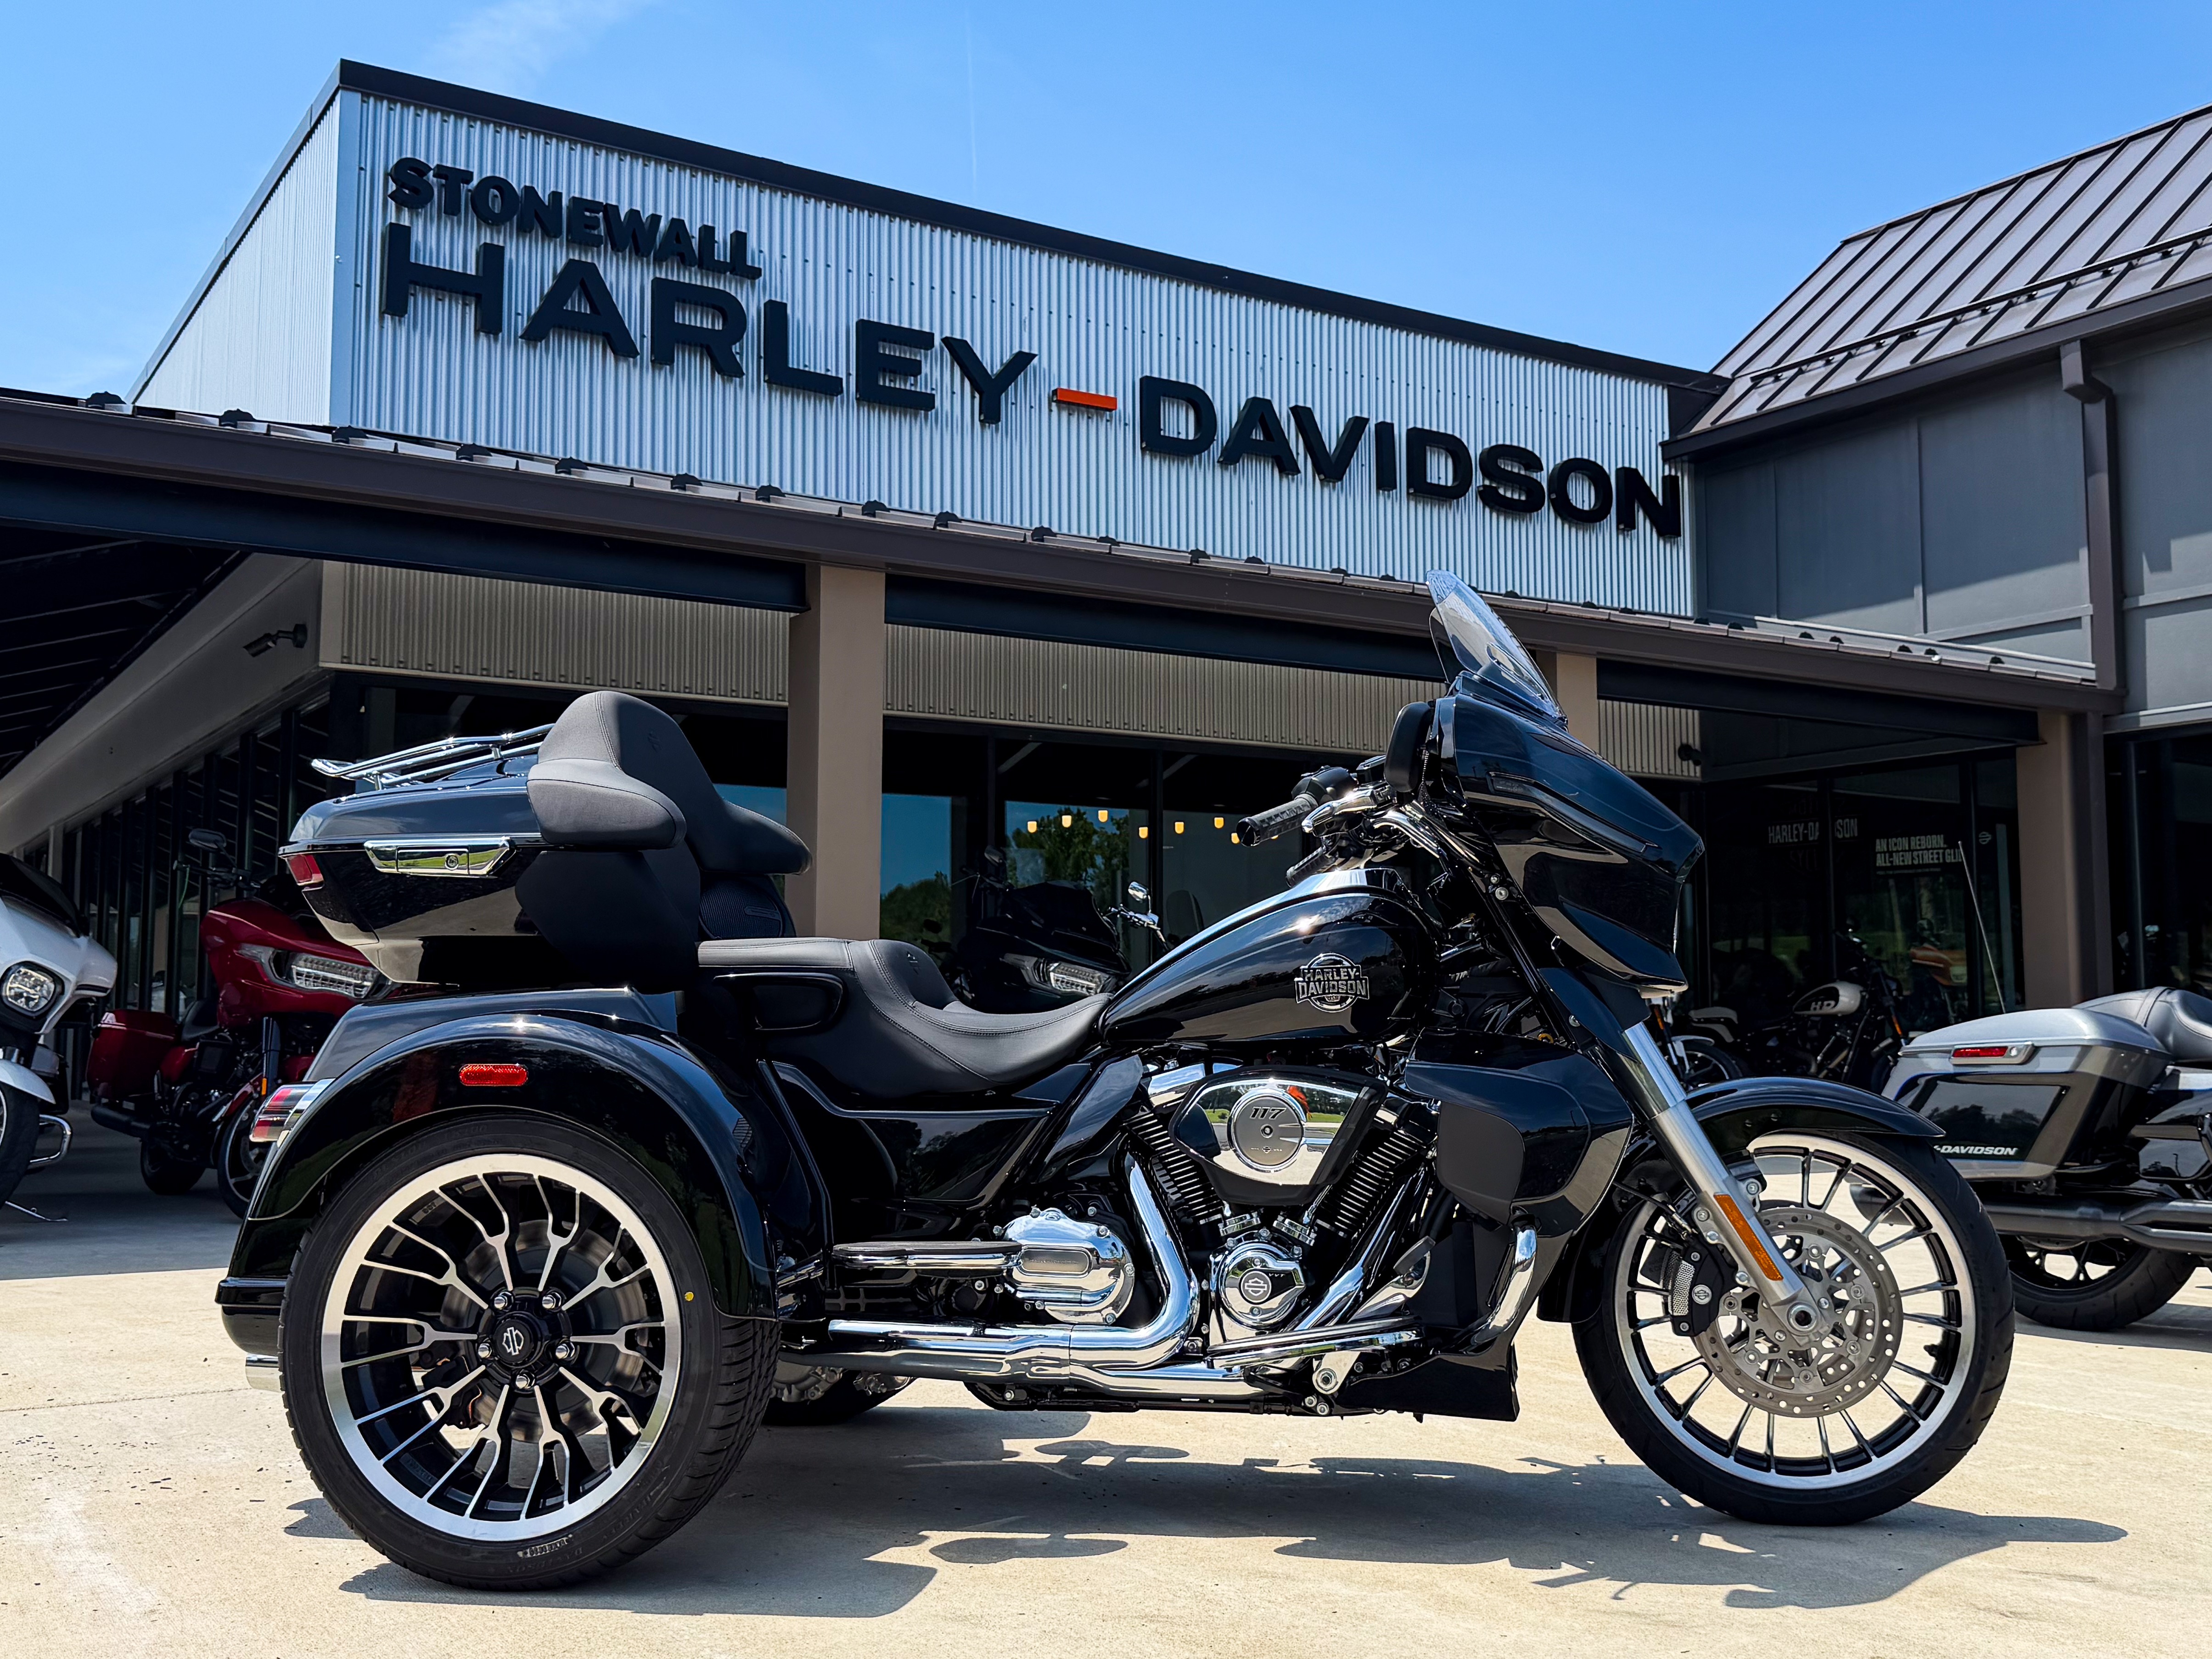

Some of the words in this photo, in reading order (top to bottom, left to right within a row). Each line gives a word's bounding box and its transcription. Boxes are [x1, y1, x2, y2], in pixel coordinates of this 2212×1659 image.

[388, 157, 762, 280] STONEWALL
[1768, 818, 1858, 844] HARLEY-DASON
[1875, 838, 1887, 852] AN
[1889, 837, 1909, 852] ICON
[1910, 834, 1949, 850] REBORN.
[1876, 851, 1912, 867] ALL-NEW
[1913, 849, 1944, 865] STREET
[1304, 968, 1359, 981] HARLEY-
[1298, 980, 1366, 999] DAVIDSON
[1250, 1106, 1286, 1119] 117
